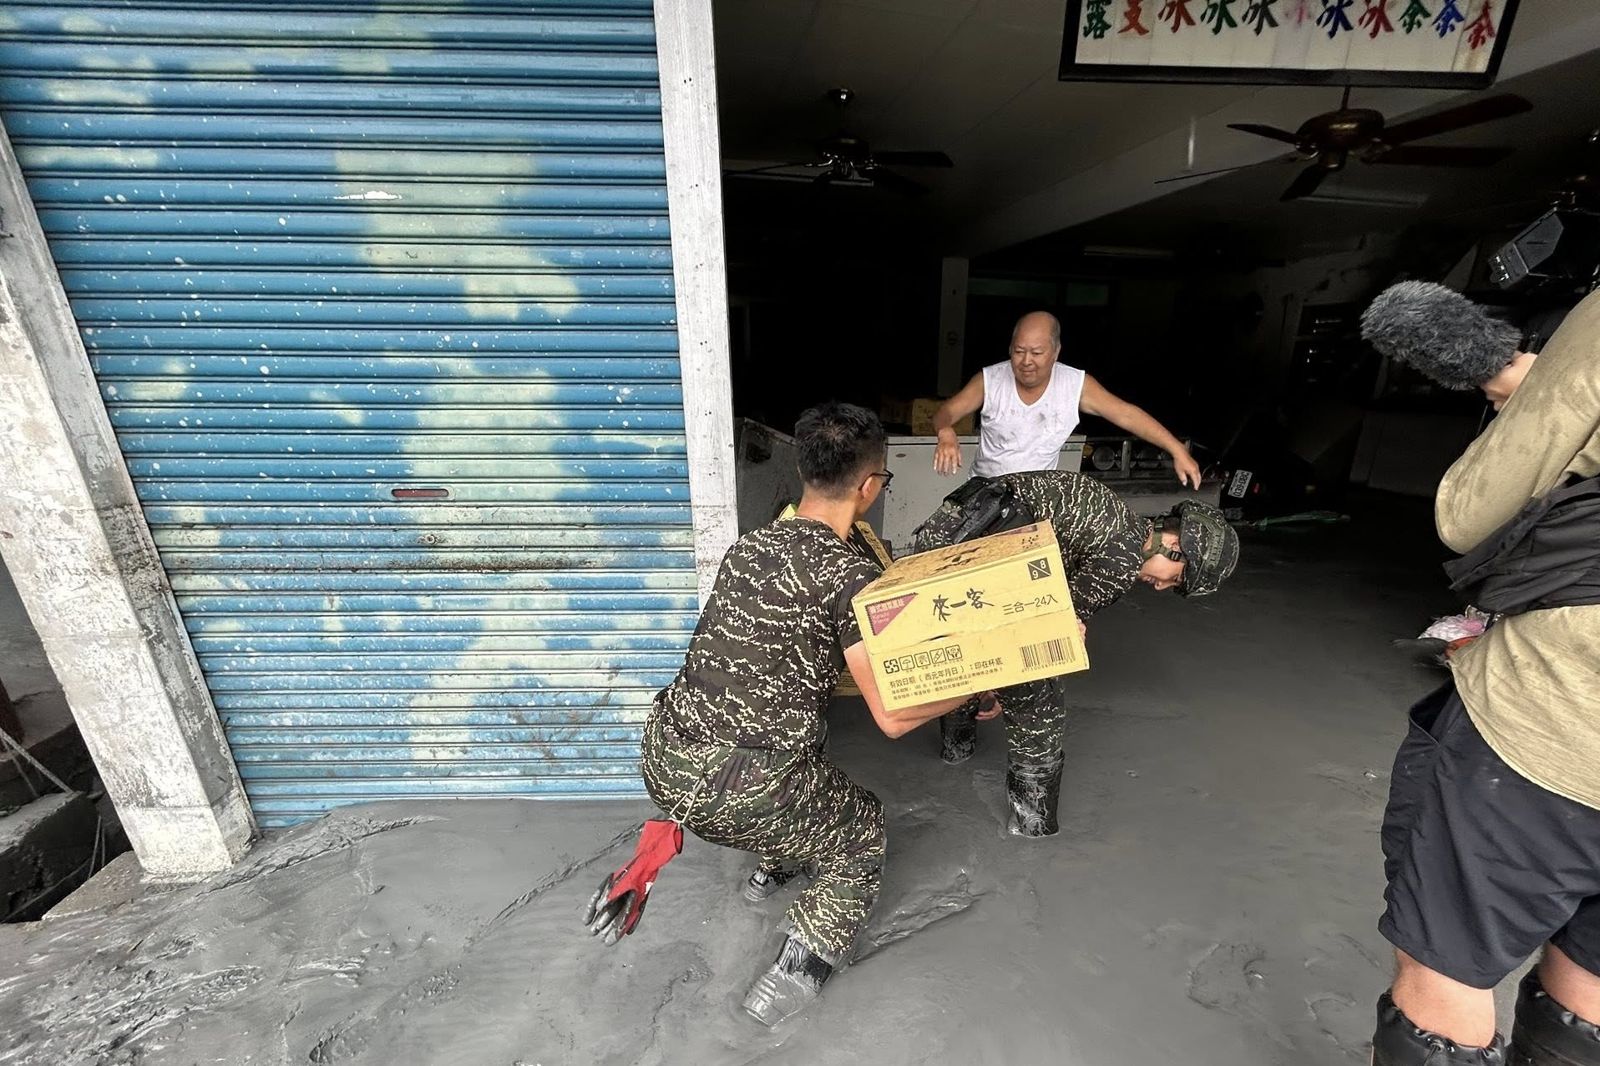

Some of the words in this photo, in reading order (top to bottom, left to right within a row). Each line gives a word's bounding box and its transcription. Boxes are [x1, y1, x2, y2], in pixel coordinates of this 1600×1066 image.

[1039, 559, 1047, 569] 8
[1031, 569, 1039, 579] 9
[933, 588, 995, 622] 來一客
[1002, 594, 1058, 616] 三合一24入
